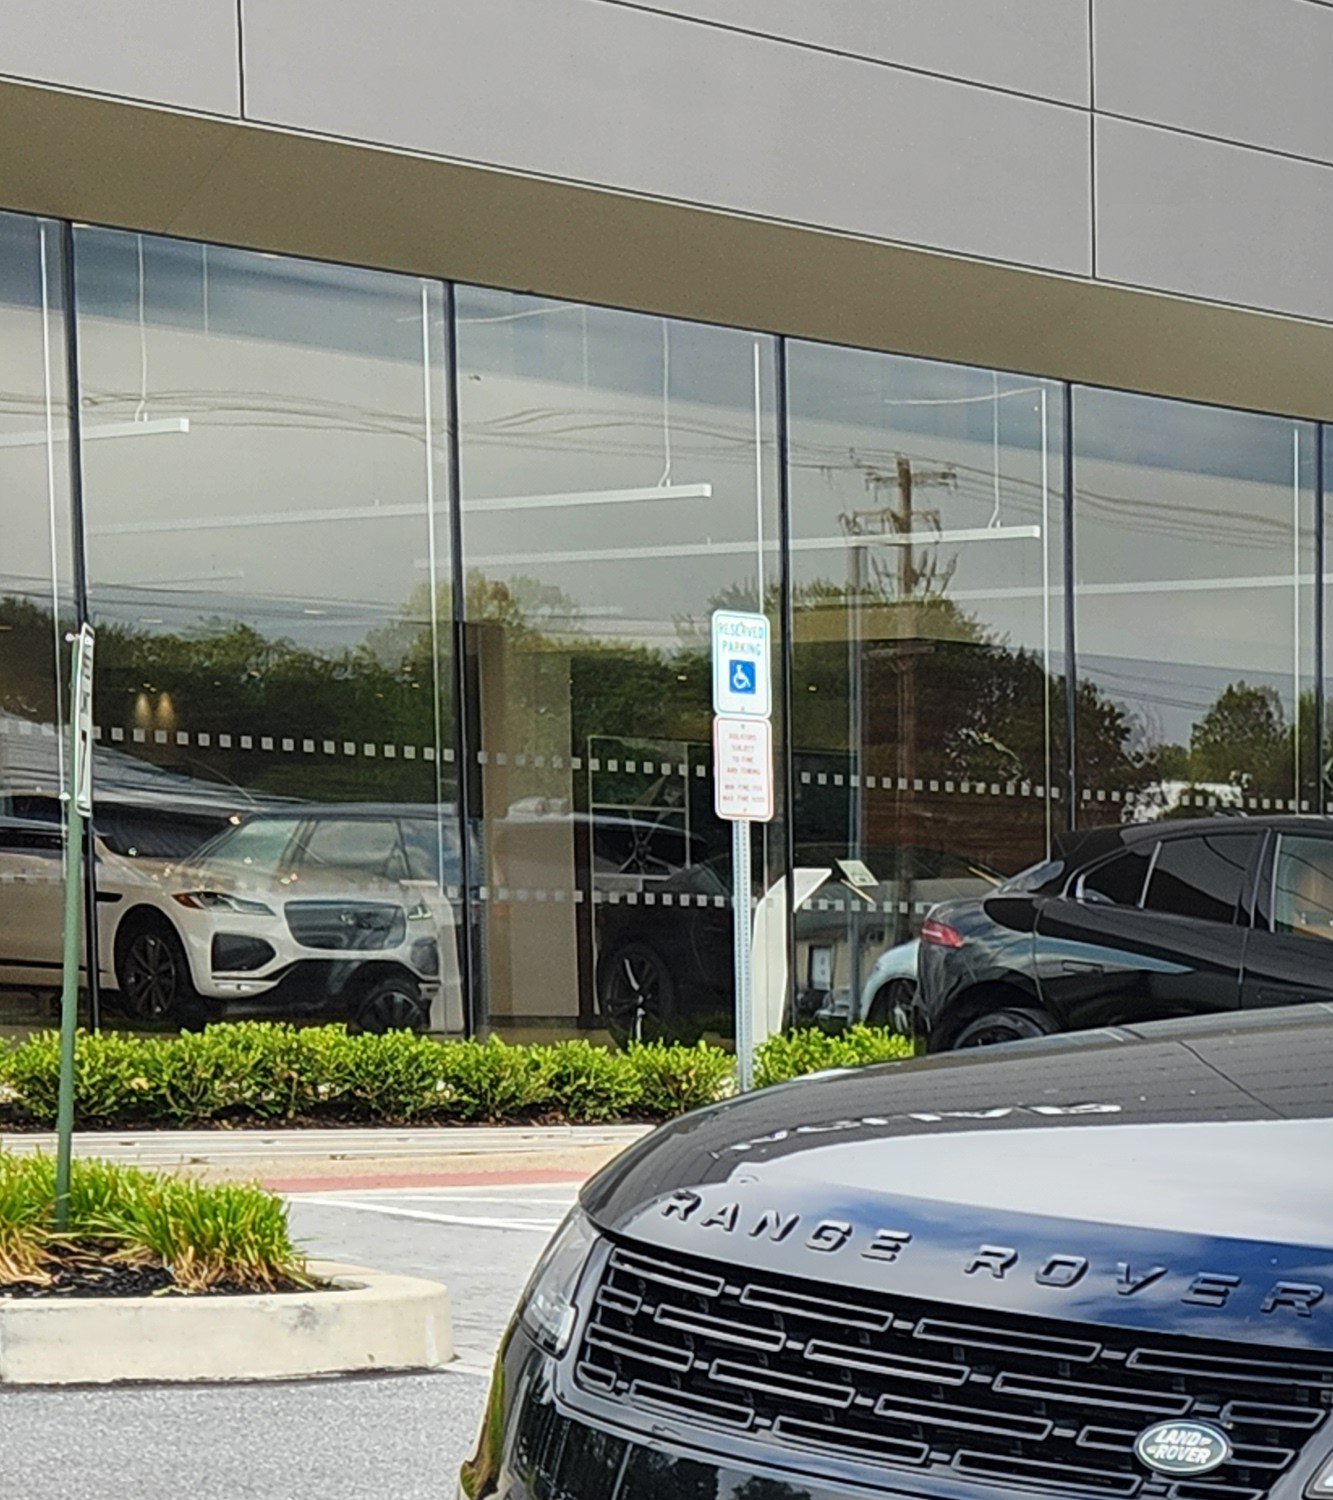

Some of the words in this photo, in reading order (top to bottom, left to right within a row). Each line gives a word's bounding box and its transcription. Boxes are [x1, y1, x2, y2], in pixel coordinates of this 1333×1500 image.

[719, 622, 764, 639] RESERVED
[722, 640, 761, 656] PARKING
[660, 1190, 911, 1262] RANGE
[964, 1243, 1326, 1318] ROVER
[1155, 1429, 1202, 1446] LAND
[1153, 1444, 1211, 1464] ROVER
